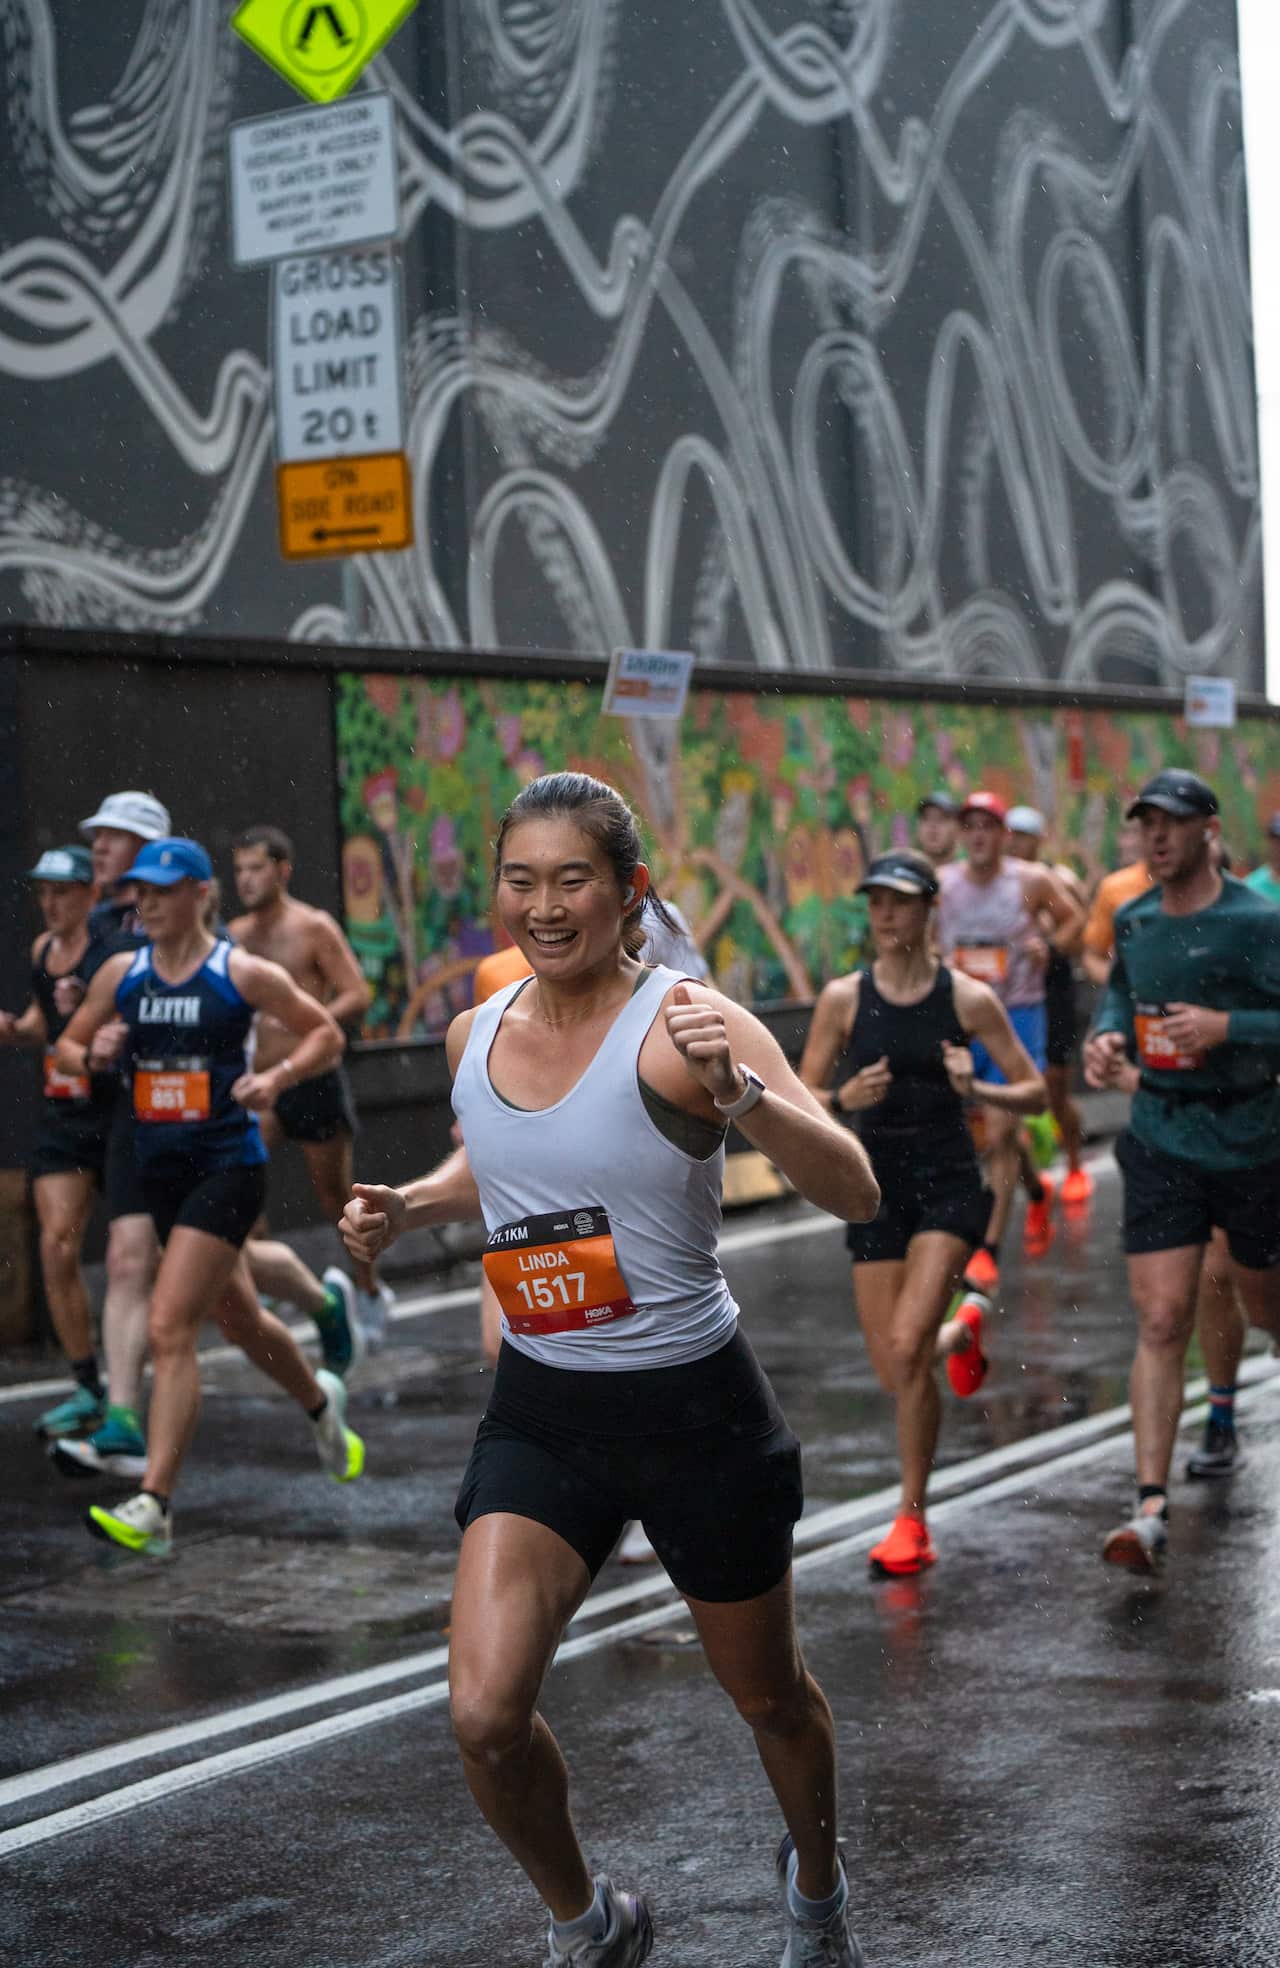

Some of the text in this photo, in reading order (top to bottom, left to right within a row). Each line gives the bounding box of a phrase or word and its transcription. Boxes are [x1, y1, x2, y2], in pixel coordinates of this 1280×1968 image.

[280, 253, 390, 297] GROSS
[290, 304, 382, 346] LOAD
[293, 355, 379, 395] LIMIT
[302, 406, 378, 445] 20 t
[138, 996, 200, 1025] LEITH
[518, 1250, 570, 1272] LINDA
[516, 1272, 585, 1309] 1517
[584, 1305, 613, 1319] HOKA
